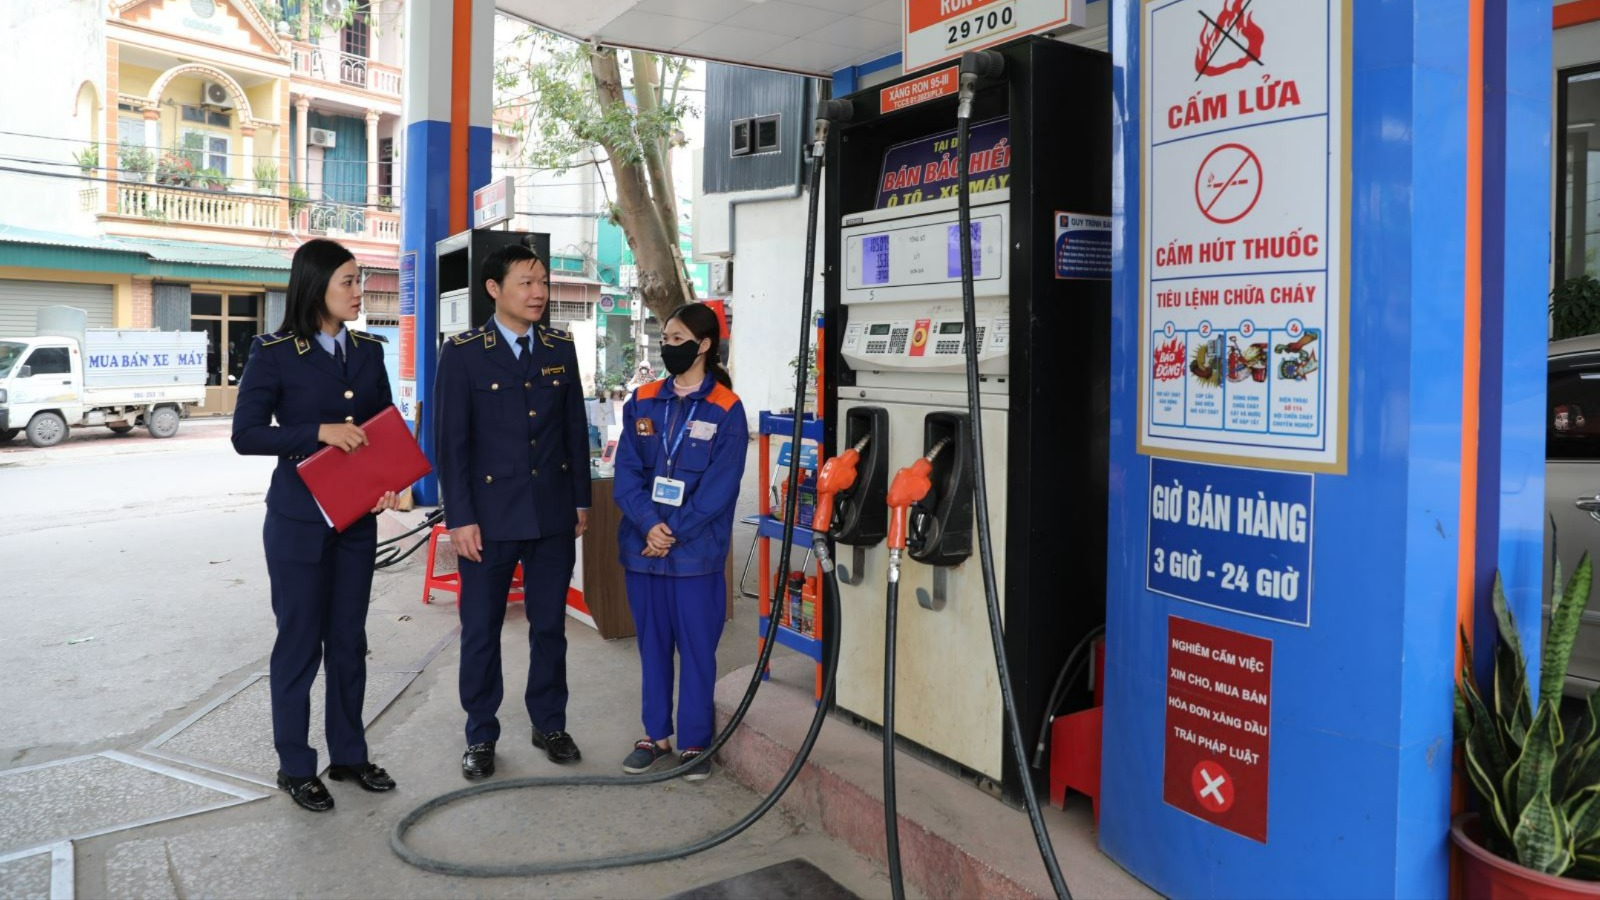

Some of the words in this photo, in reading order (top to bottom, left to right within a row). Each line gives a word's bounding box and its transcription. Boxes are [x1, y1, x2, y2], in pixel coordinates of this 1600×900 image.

[948, 6, 1013, 44] 29700
[912, 80, 929, 95] RON
[1168, 90, 1227, 129] CẤM
[1238, 74, 1301, 115] LỬA
[934, 140, 949, 154] TẠI
[883, 164, 922, 192] BÁN
[903, 189, 923, 205] TÔ
[940, 184, 959, 199] XE
[969, 174, 1010, 194] MÁY
[1103, 219, 1112, 229] BÁ
[1156, 238, 1193, 268] CẤM
[1199, 237, 1236, 263] HÚT
[1243, 227, 1319, 260] THUỐC
[869, 289, 875, 301] 5
[1157, 289, 1181, 308] TIÊU
[1185, 287, 1219, 310] LỆNH
[1224, 284, 1265, 305] CHỮA
[1270, 283, 1316, 304] CHÁY
[1166, 326, 1172, 334] 1
[1201, 325, 1209, 334] 2
[1243, 324, 1251, 333] 3
[1290, 324, 1299, 333] 4
[89, 354, 119, 368] MUA
[121, 351, 149, 367] BÁN
[153, 353, 169, 366] XE
[178, 350, 205, 365] MÁY
[1152, 479, 1183, 523] GIỜ
[1187, 485, 1231, 532] BÁN
[1237, 491, 1307, 543] HÀNG
[1154, 547, 1165, 573] 3
[1169, 549, 1202, 582] GIỜ
[1206, 570, 1215, 578] -
[1221, 562, 1249, 592] 24
[1256, 565, 1300, 601] GIỜ
[1172, 638, 1210, 659] NGHIÊM
[1212, 648, 1236, 665] CẤM
[1238, 656, 1265, 673] VIỆC
[1170, 667, 1186, 681] XIN
[1188, 673, 1212, 691] CHO,
[1215, 681, 1239, 698] MUA
[1242, 688, 1267, 705] BÁN
[1168, 696, 1187, 712] HÓA
[1189, 704, 1210, 721] ĐƠN
[1244, 718, 1267, 736] DẦU
[1174, 726, 1196, 744] TRÁI
[1198, 734, 1227, 754] PHÁP
[1229, 746, 1260, 765] LUẬT
